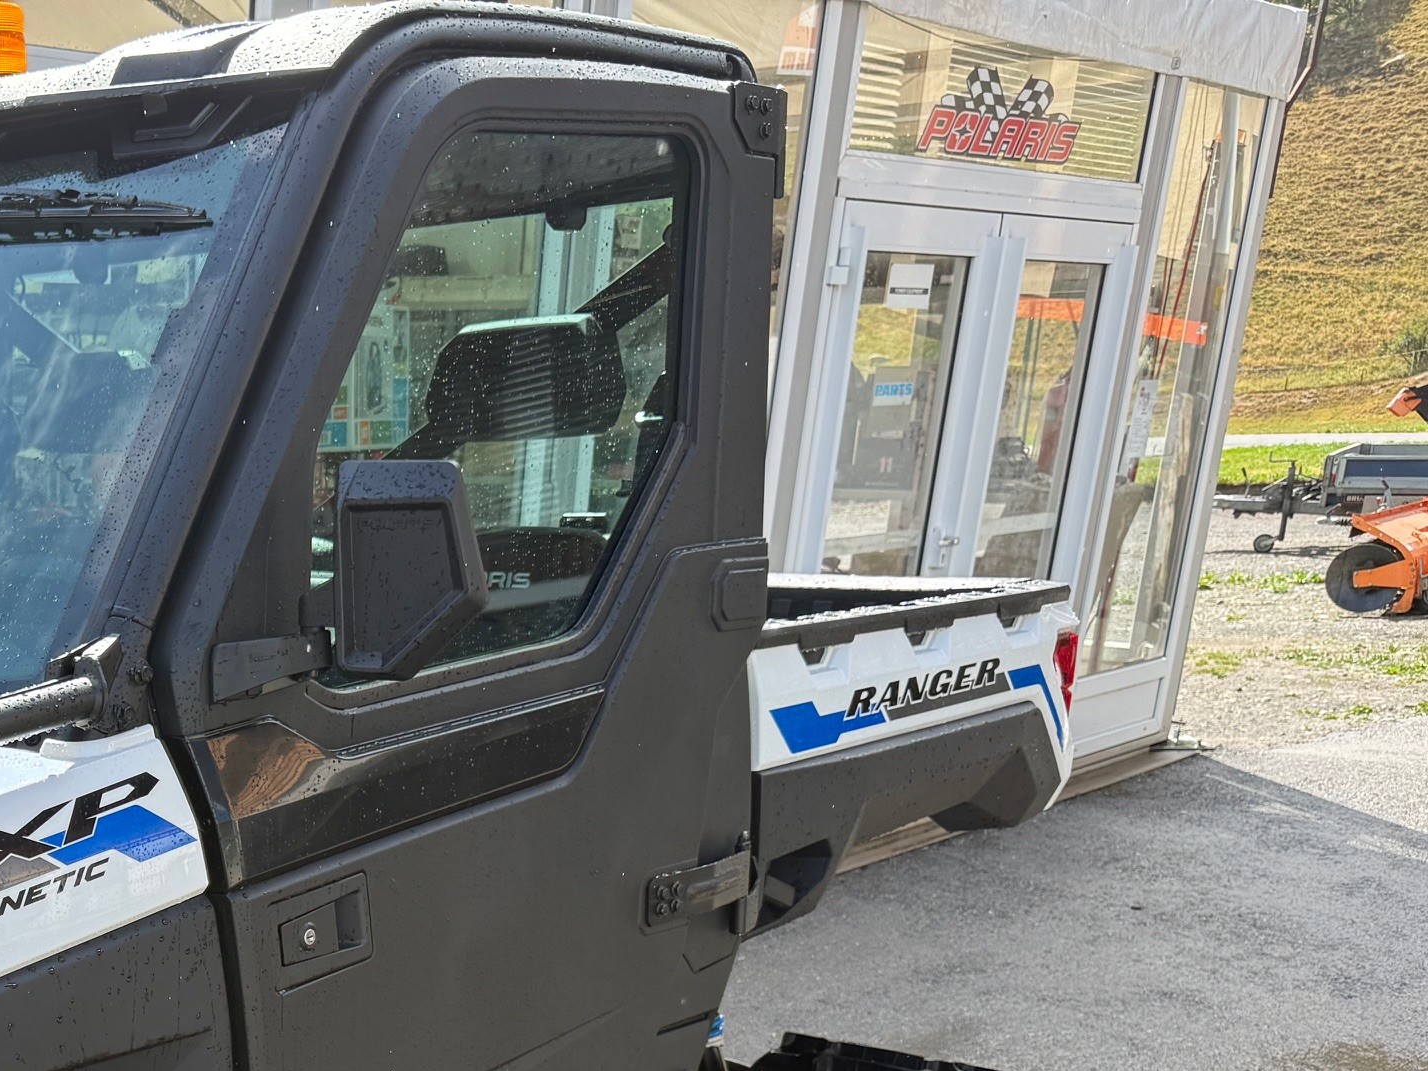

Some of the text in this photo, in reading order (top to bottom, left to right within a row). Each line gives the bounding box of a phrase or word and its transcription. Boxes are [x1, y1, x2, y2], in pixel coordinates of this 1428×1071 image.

[917, 106, 1081, 163] POLARIS
[874, 383, 913, 397] PARTS
[483, 571, 531, 590] RIS
[845, 657, 1001, 720] RANGER
